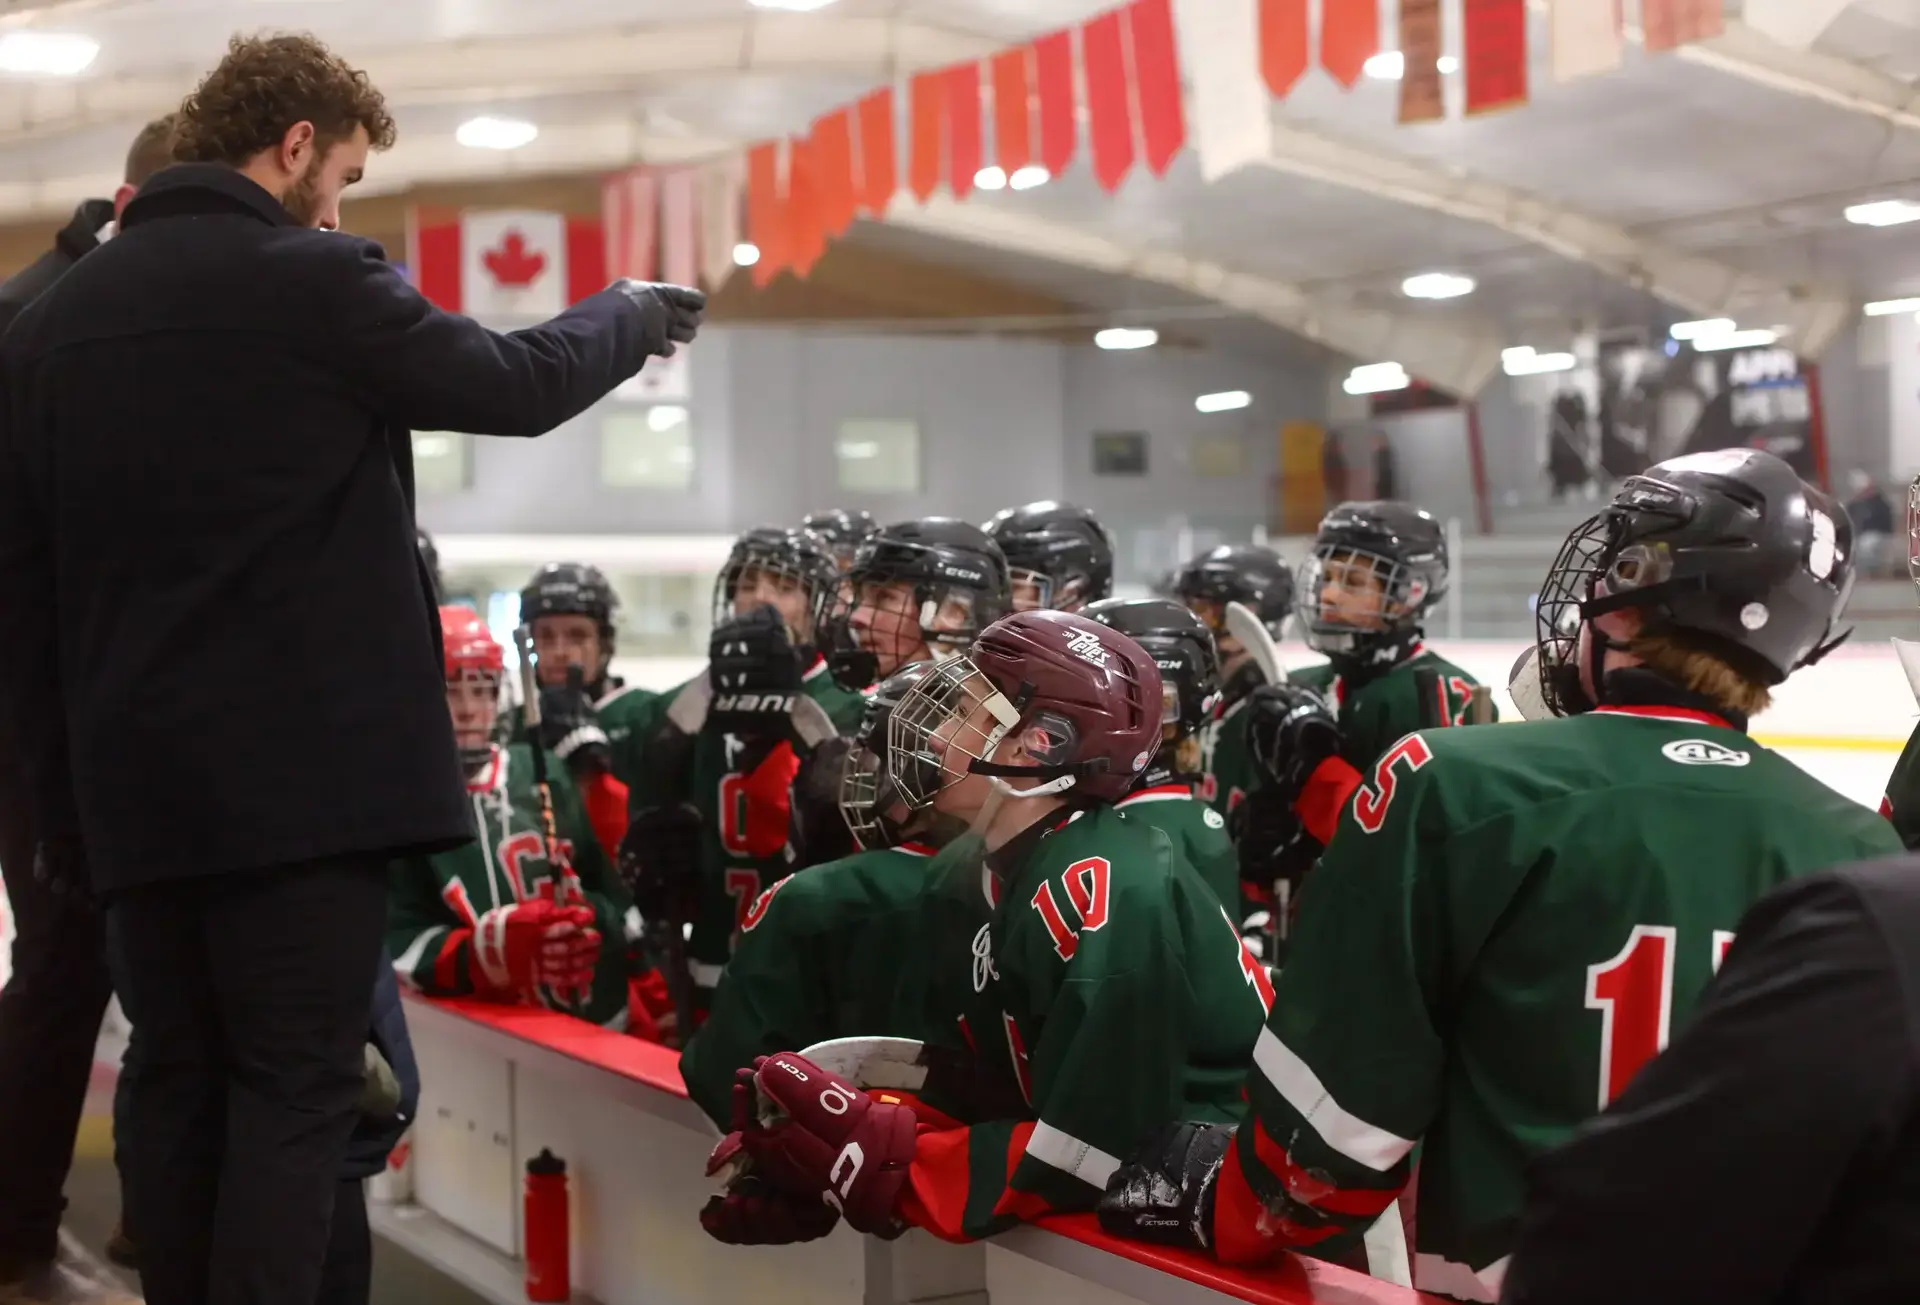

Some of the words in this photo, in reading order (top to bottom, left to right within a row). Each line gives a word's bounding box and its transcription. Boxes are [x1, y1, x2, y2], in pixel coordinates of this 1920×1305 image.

[945, 567, 982, 580] CCM
[1067, 626, 1111, 664] Petes
[1155, 660, 1183, 670] CM
[1031, 856, 1111, 962] 10
[775, 1060, 809, 1082] CCM
[819, 1081, 857, 1115] 10
